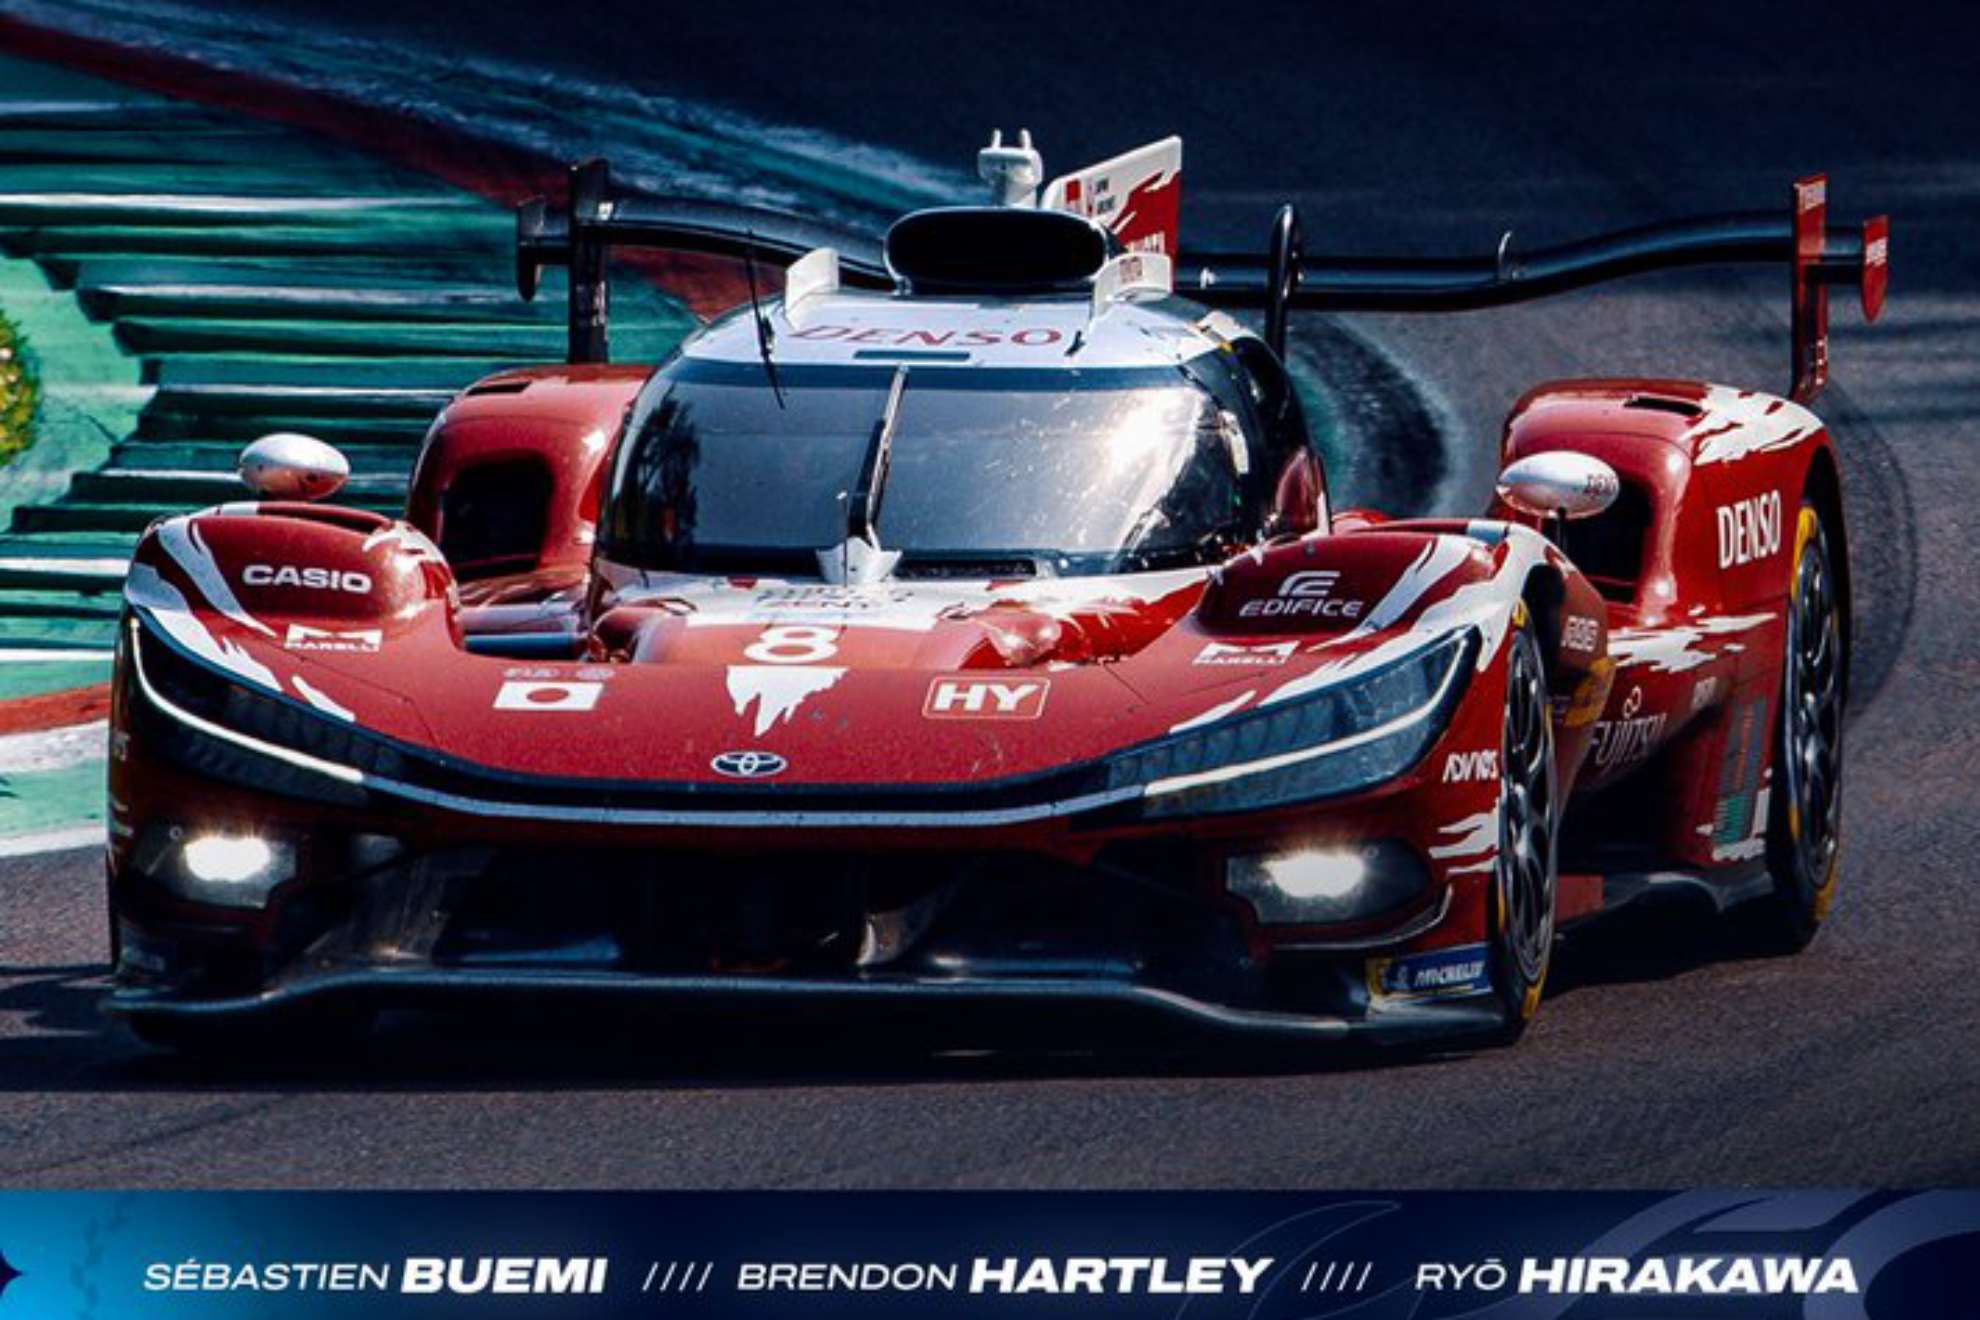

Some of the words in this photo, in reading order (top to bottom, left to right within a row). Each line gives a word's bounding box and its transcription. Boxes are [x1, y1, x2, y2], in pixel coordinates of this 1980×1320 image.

[788, 325, 1062, 346] DENSO
[1716, 489, 1781, 569] DENSO
[242, 564, 372, 594] CASIO
[1239, 600, 1364, 617] EDIFICE
[743, 626, 840, 663] 8
[932, 683, 1040, 711] HY
